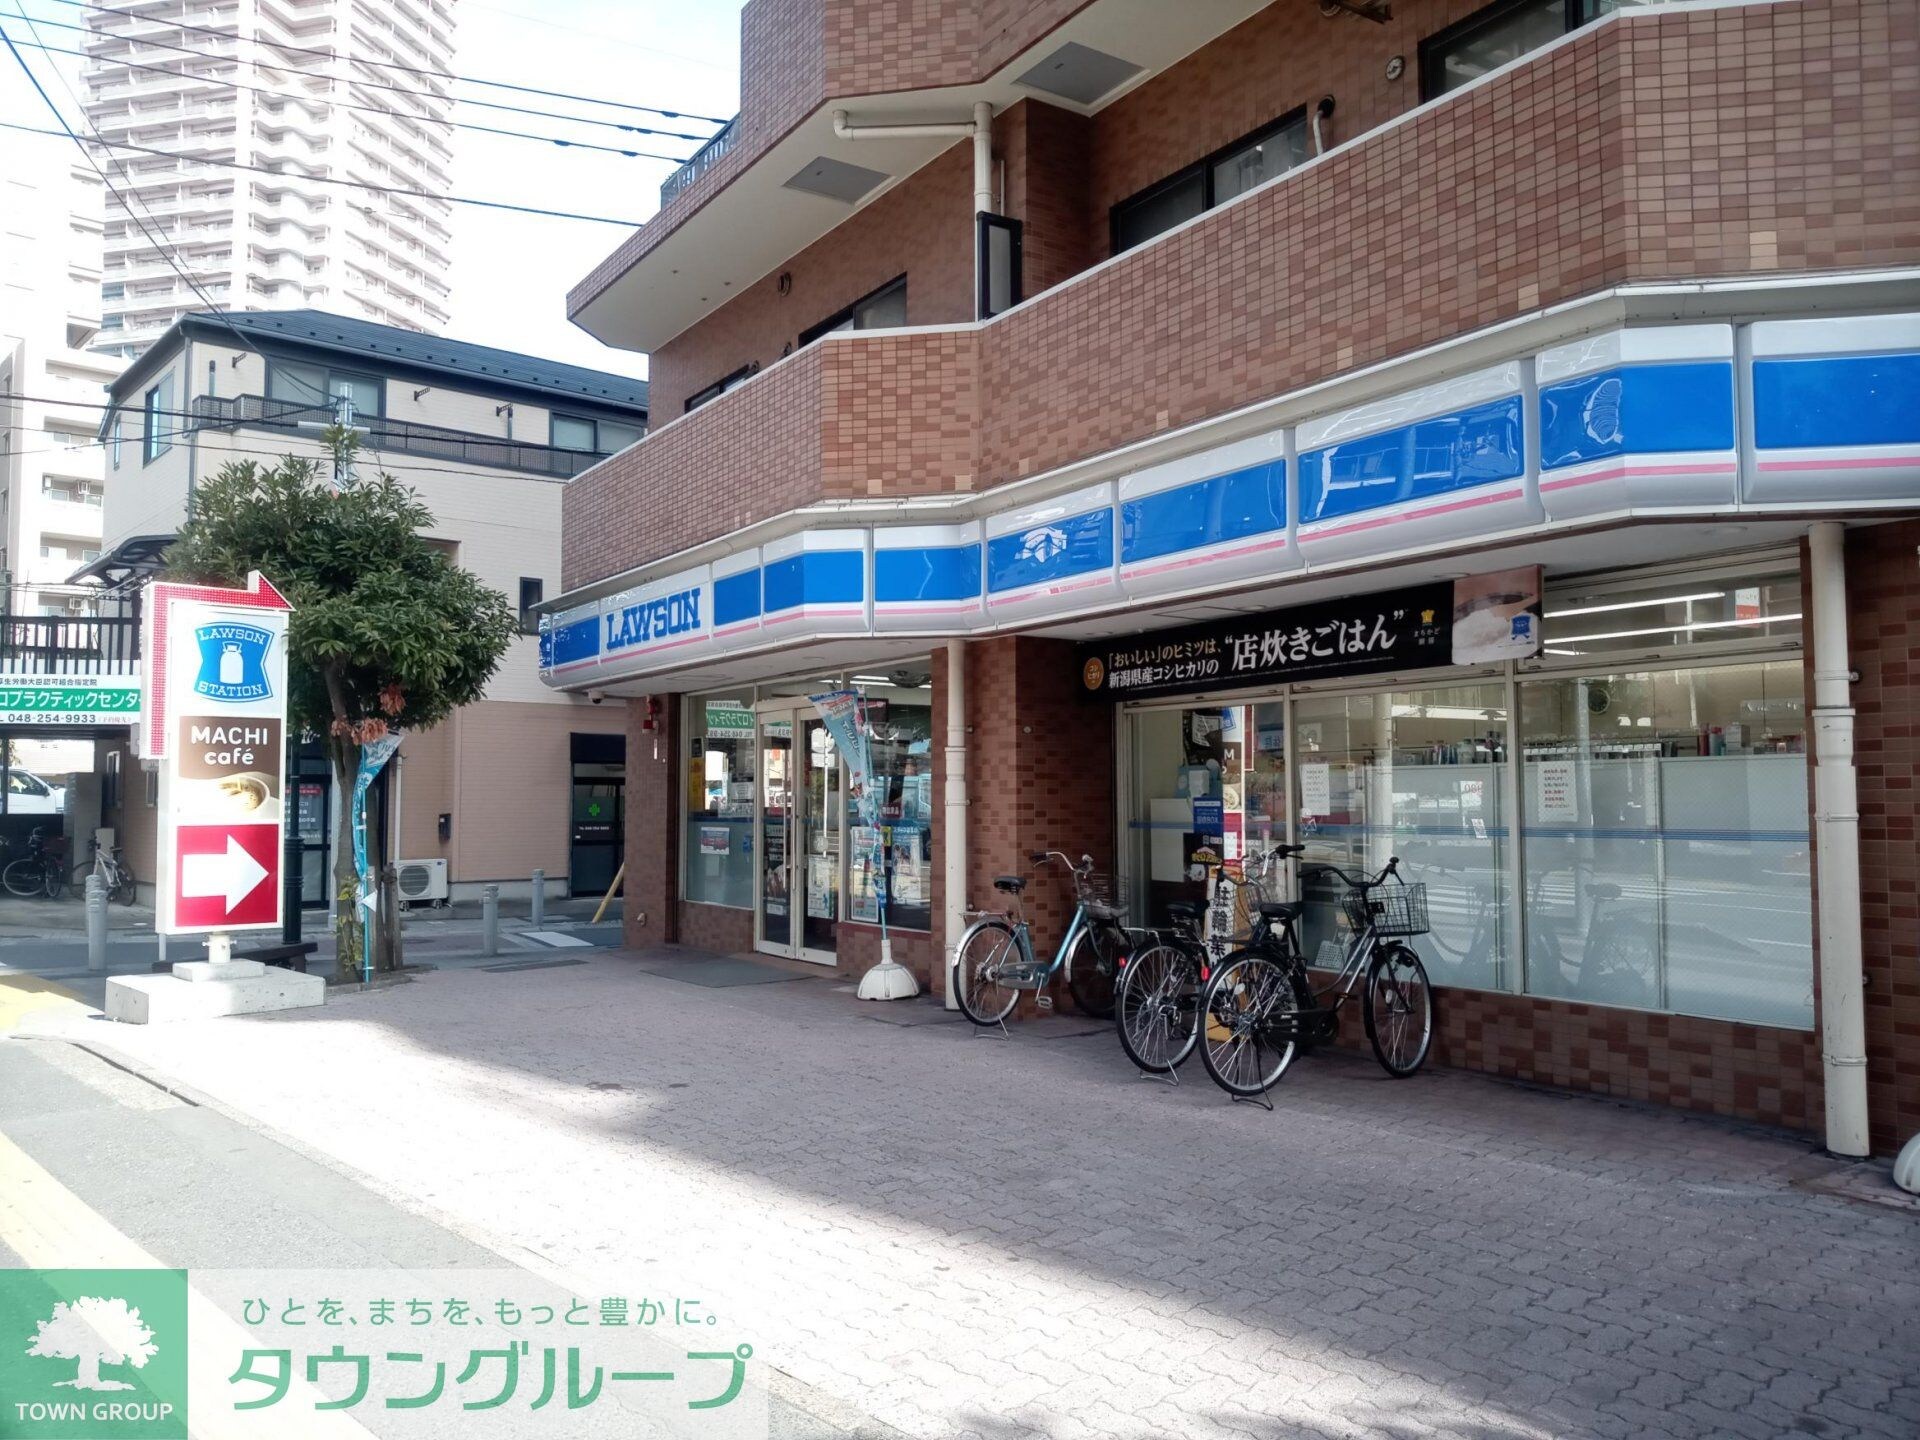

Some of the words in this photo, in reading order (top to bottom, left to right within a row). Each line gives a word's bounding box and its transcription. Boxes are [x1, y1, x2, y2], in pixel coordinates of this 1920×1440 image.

[607, 587, 700, 650] LAWSON
[198, 628, 266, 645] LAWSON
[1109, 659, 1219, 689] 新潟県産コシヒカリの
[198, 680, 263, 697] STATION
[8, 713, 96, 723] 048-254-9933
[191, 725, 268, 745] MACHI
[204, 747, 254, 765] café
